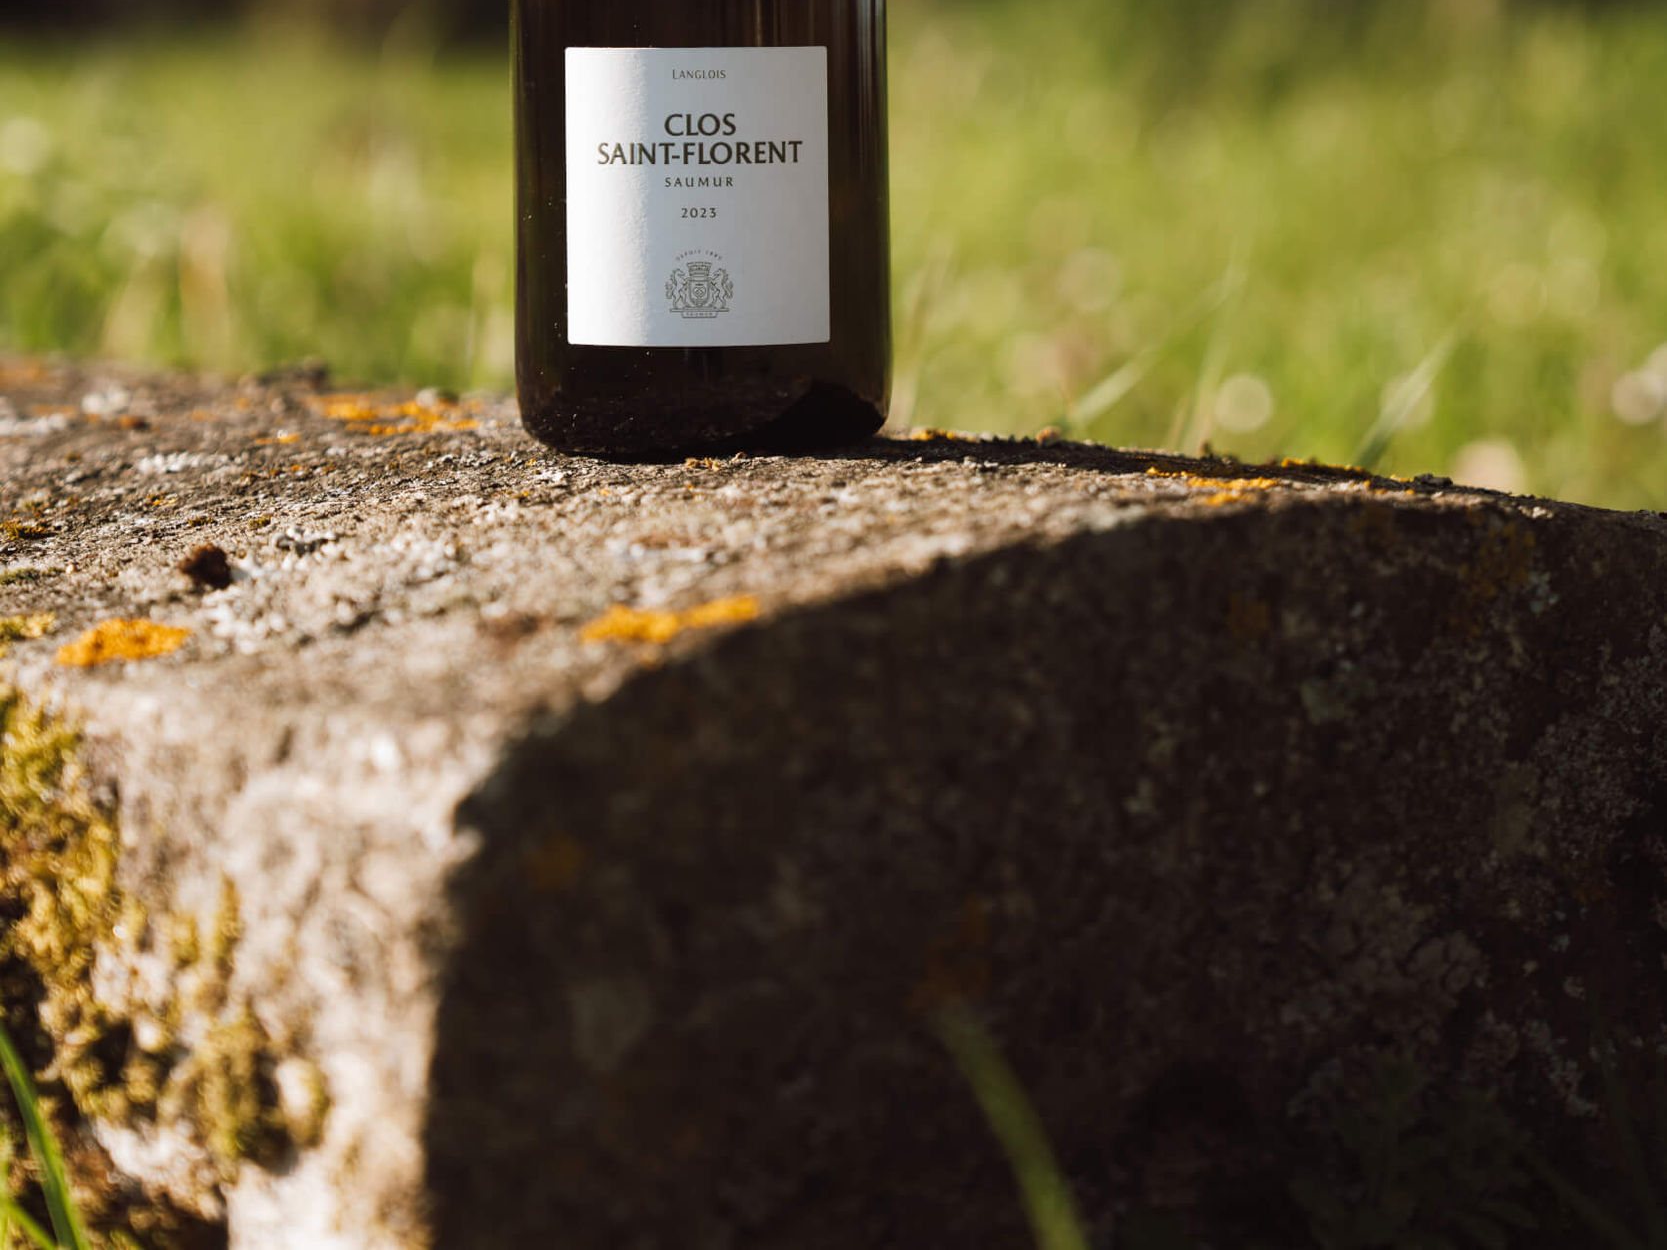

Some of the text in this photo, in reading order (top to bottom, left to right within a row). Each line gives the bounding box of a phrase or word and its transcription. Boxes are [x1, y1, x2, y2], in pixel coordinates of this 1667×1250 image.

[672, 68, 726, 80] LANGLOIS
[664, 113, 736, 137] CLOS
[597, 141, 803, 165] SAINT-FLORENT
[664, 176, 734, 188] SAUMUR
[681, 207, 717, 219] 2023
